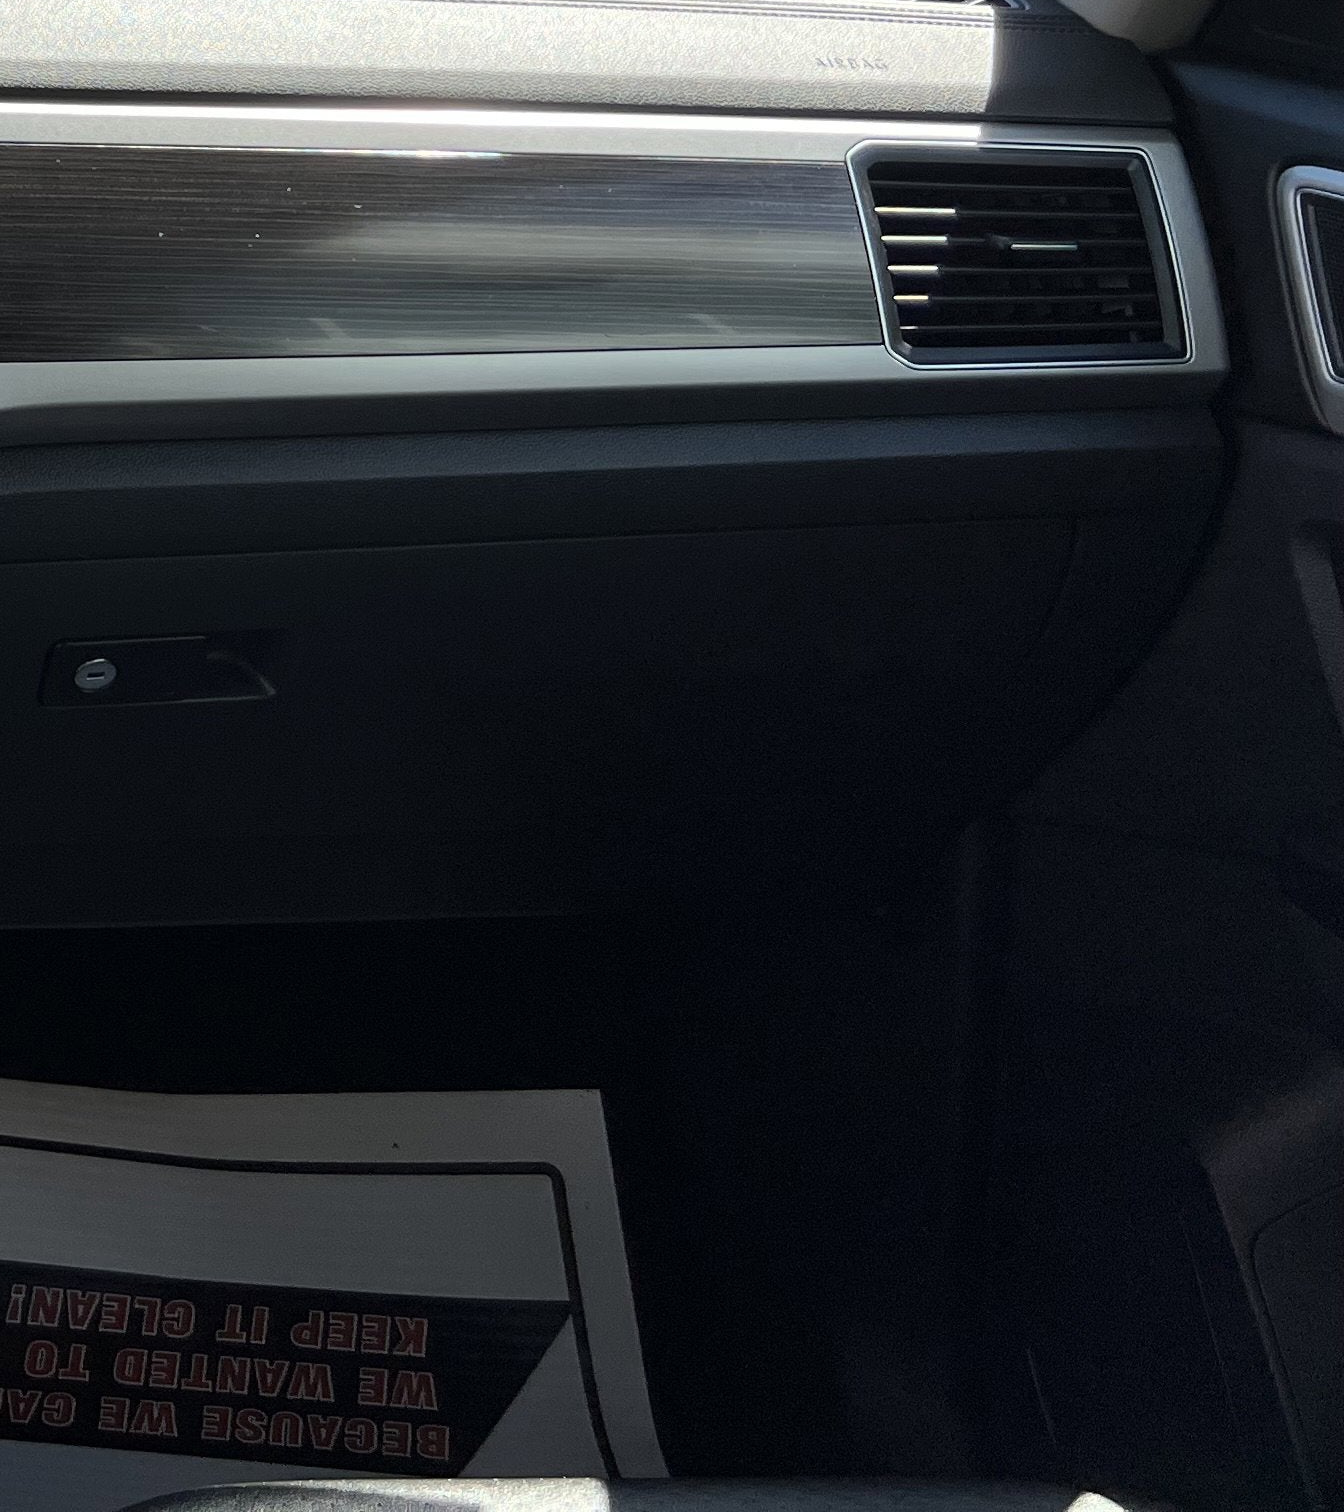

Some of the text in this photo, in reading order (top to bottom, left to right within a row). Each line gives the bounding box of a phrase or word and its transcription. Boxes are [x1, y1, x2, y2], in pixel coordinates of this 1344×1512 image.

[4, 1283, 430, 1358] KEEP IT CLEAN!
[22, 1338, 439, 1411] WE WANTED TO
[98, 1395, 180, 1438] WE
[200, 1403, 451, 1461] BECAUSE
